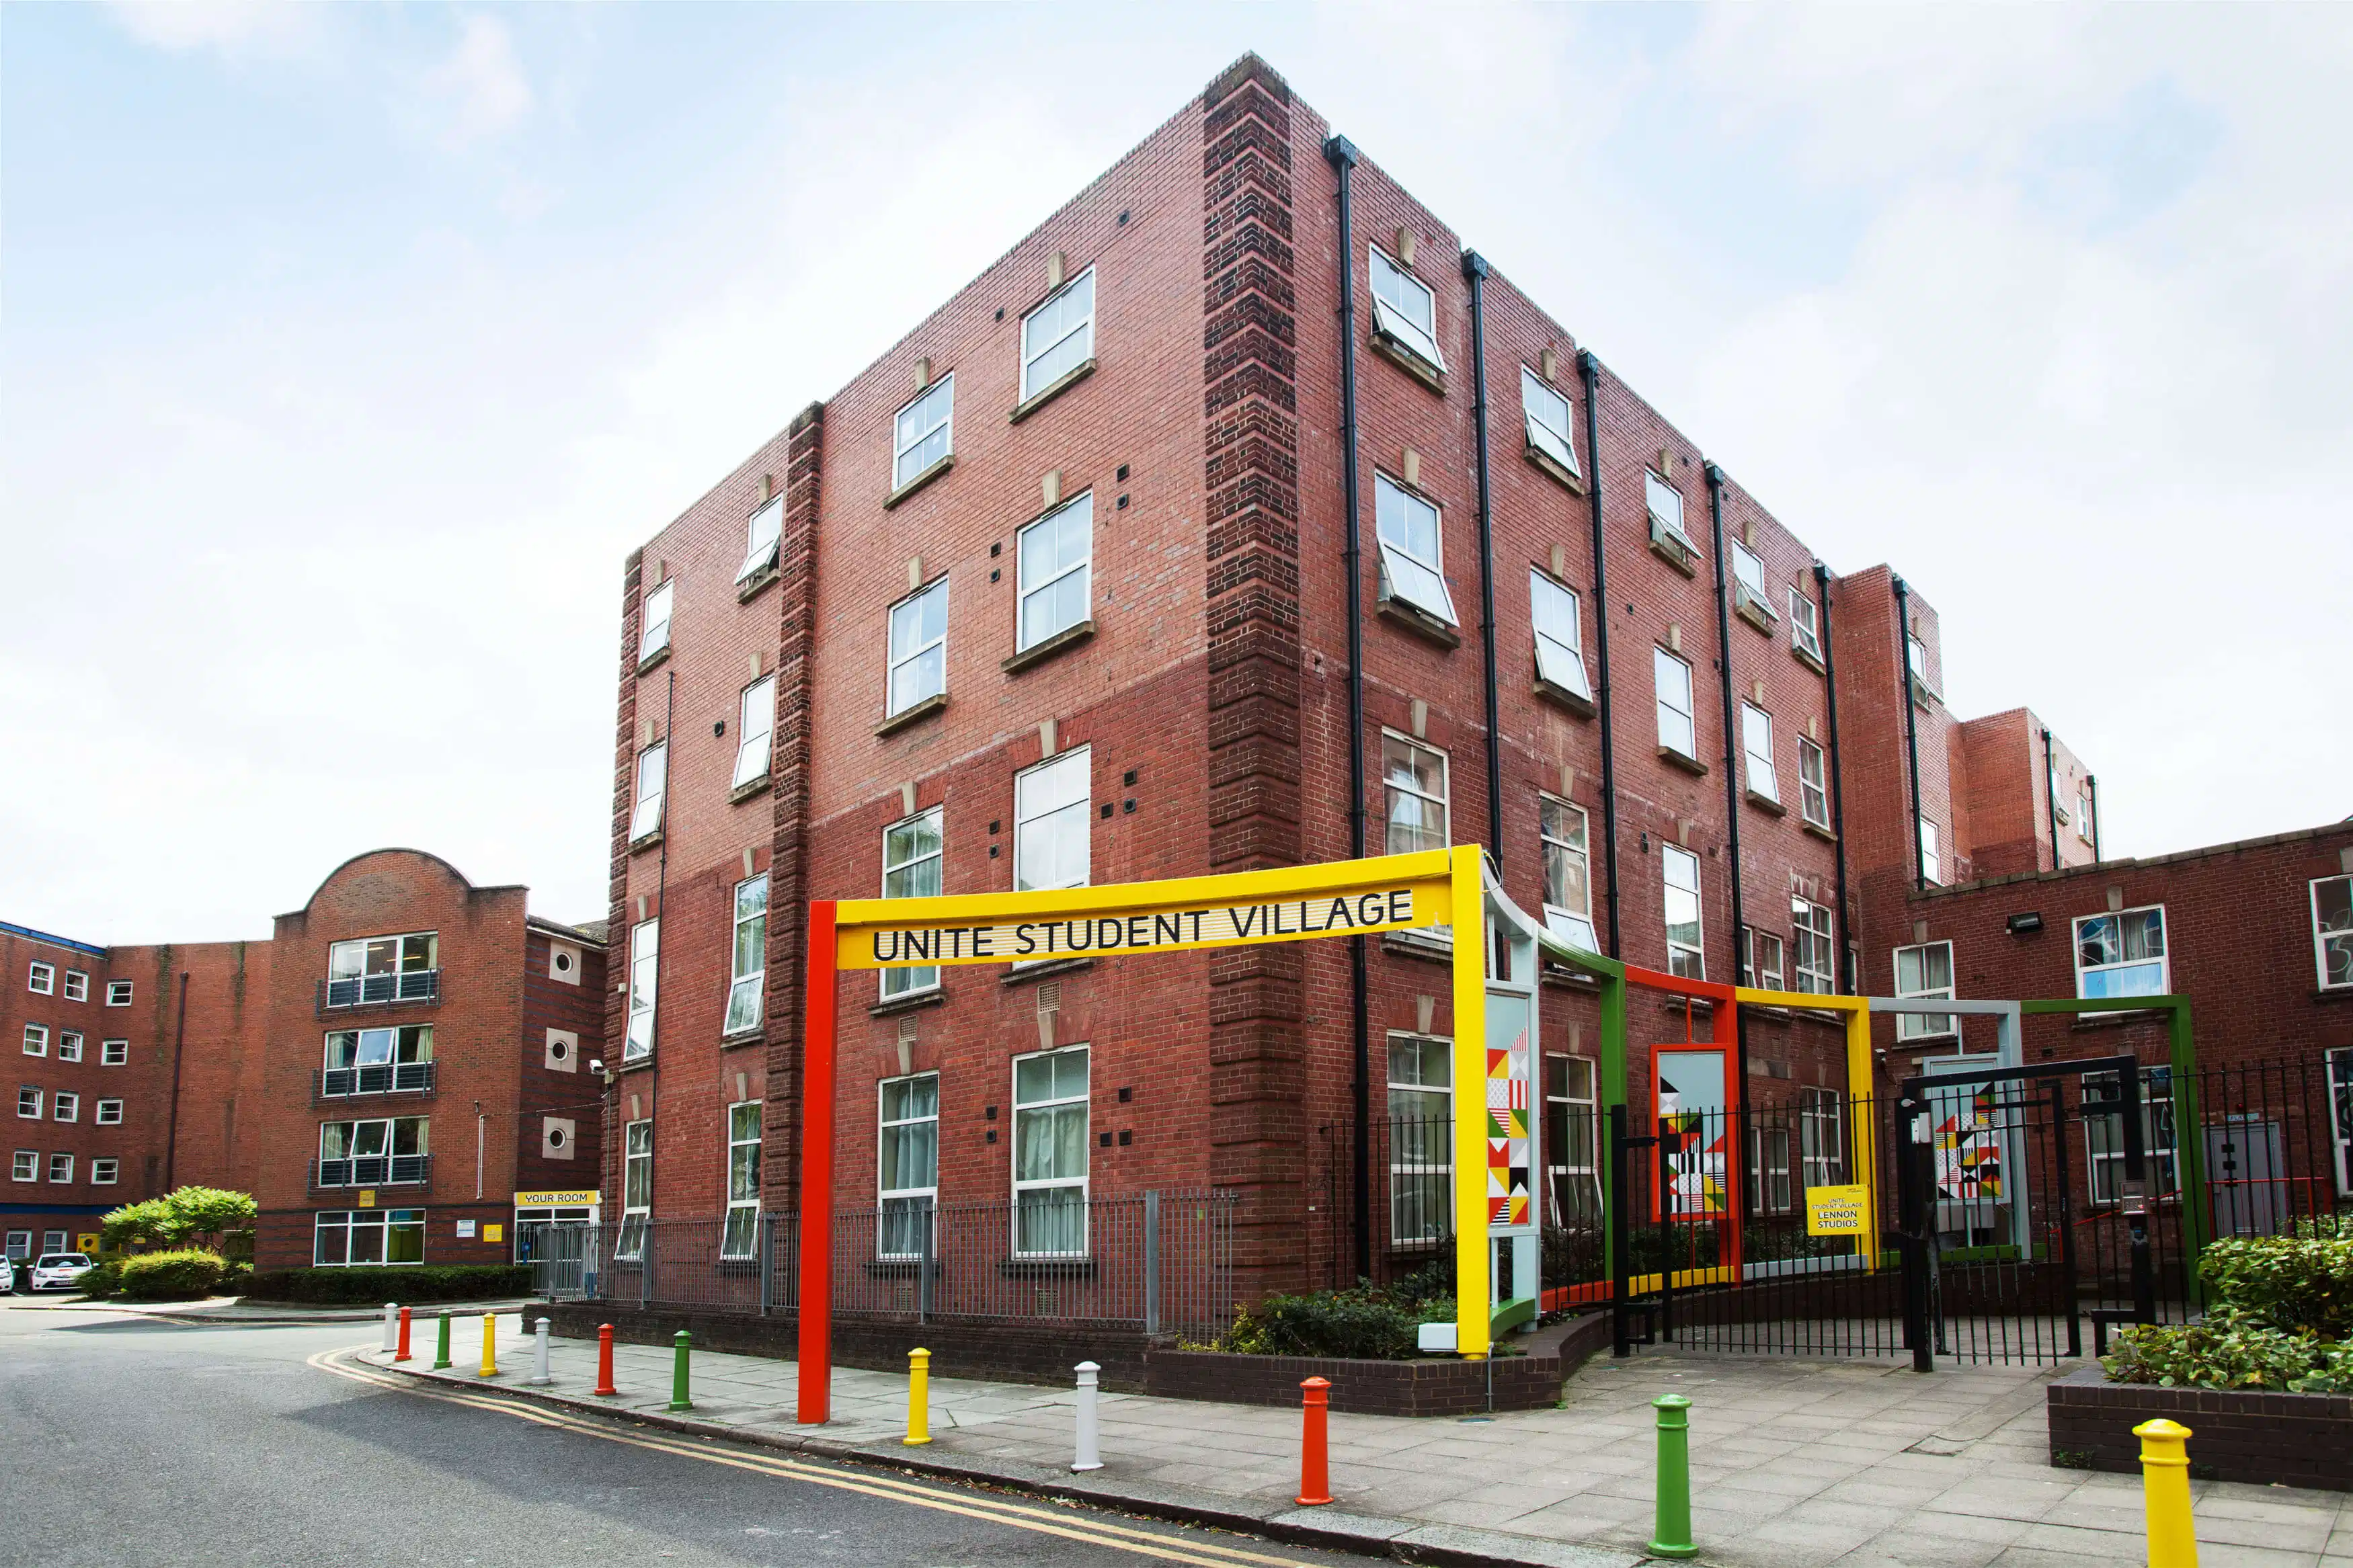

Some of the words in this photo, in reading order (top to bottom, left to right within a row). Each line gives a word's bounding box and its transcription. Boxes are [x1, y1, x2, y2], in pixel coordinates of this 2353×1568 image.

[873, 926, 994, 961] UNITE
[1015, 910, 1209, 954] STUDENT
[1228, 889, 1412, 938] VILLAGE
[526, 1194, 554, 1202] YOUR
[558, 1194, 588, 1202] ROOM
[1818, 1210, 1857, 1219] LENNON
[1818, 1220, 1858, 1229] STUDIOS
